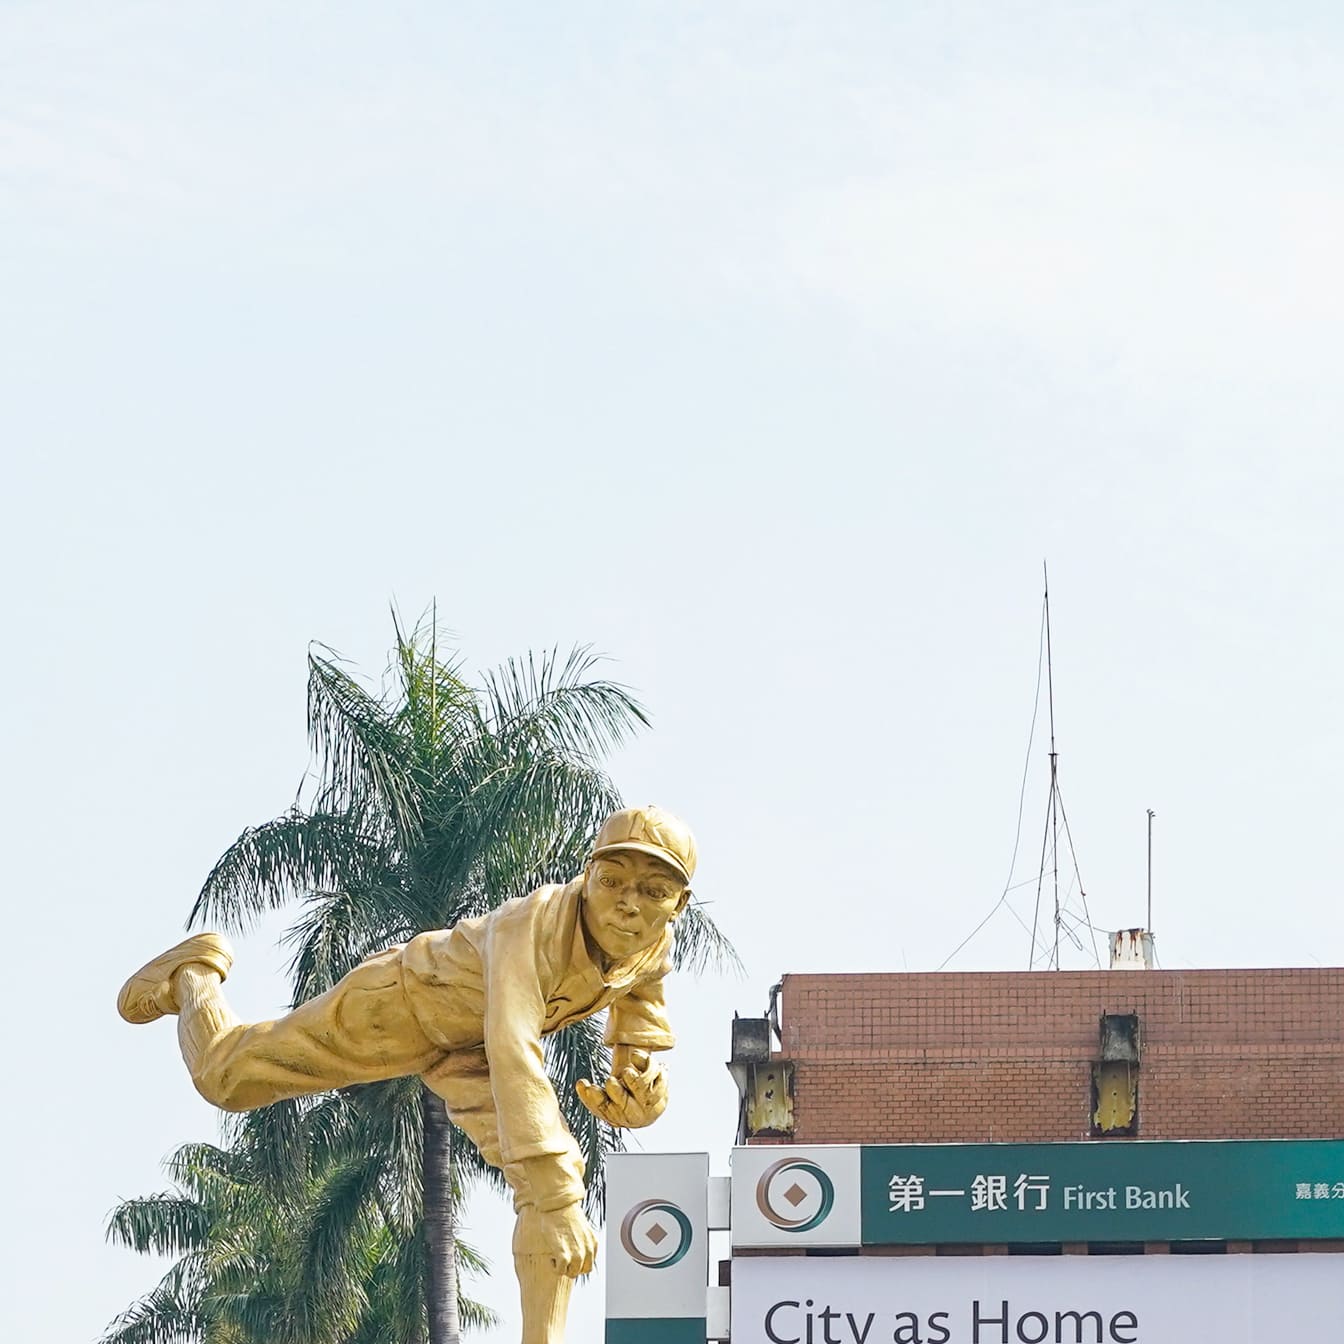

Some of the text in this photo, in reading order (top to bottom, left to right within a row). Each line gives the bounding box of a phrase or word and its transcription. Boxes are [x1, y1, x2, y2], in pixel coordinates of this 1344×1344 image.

[888, 1174, 1191, 1213] 第一銀行 First Bank
[893, 1311, 951, 1344] as
[971, 1300, 1139, 1344] Home
